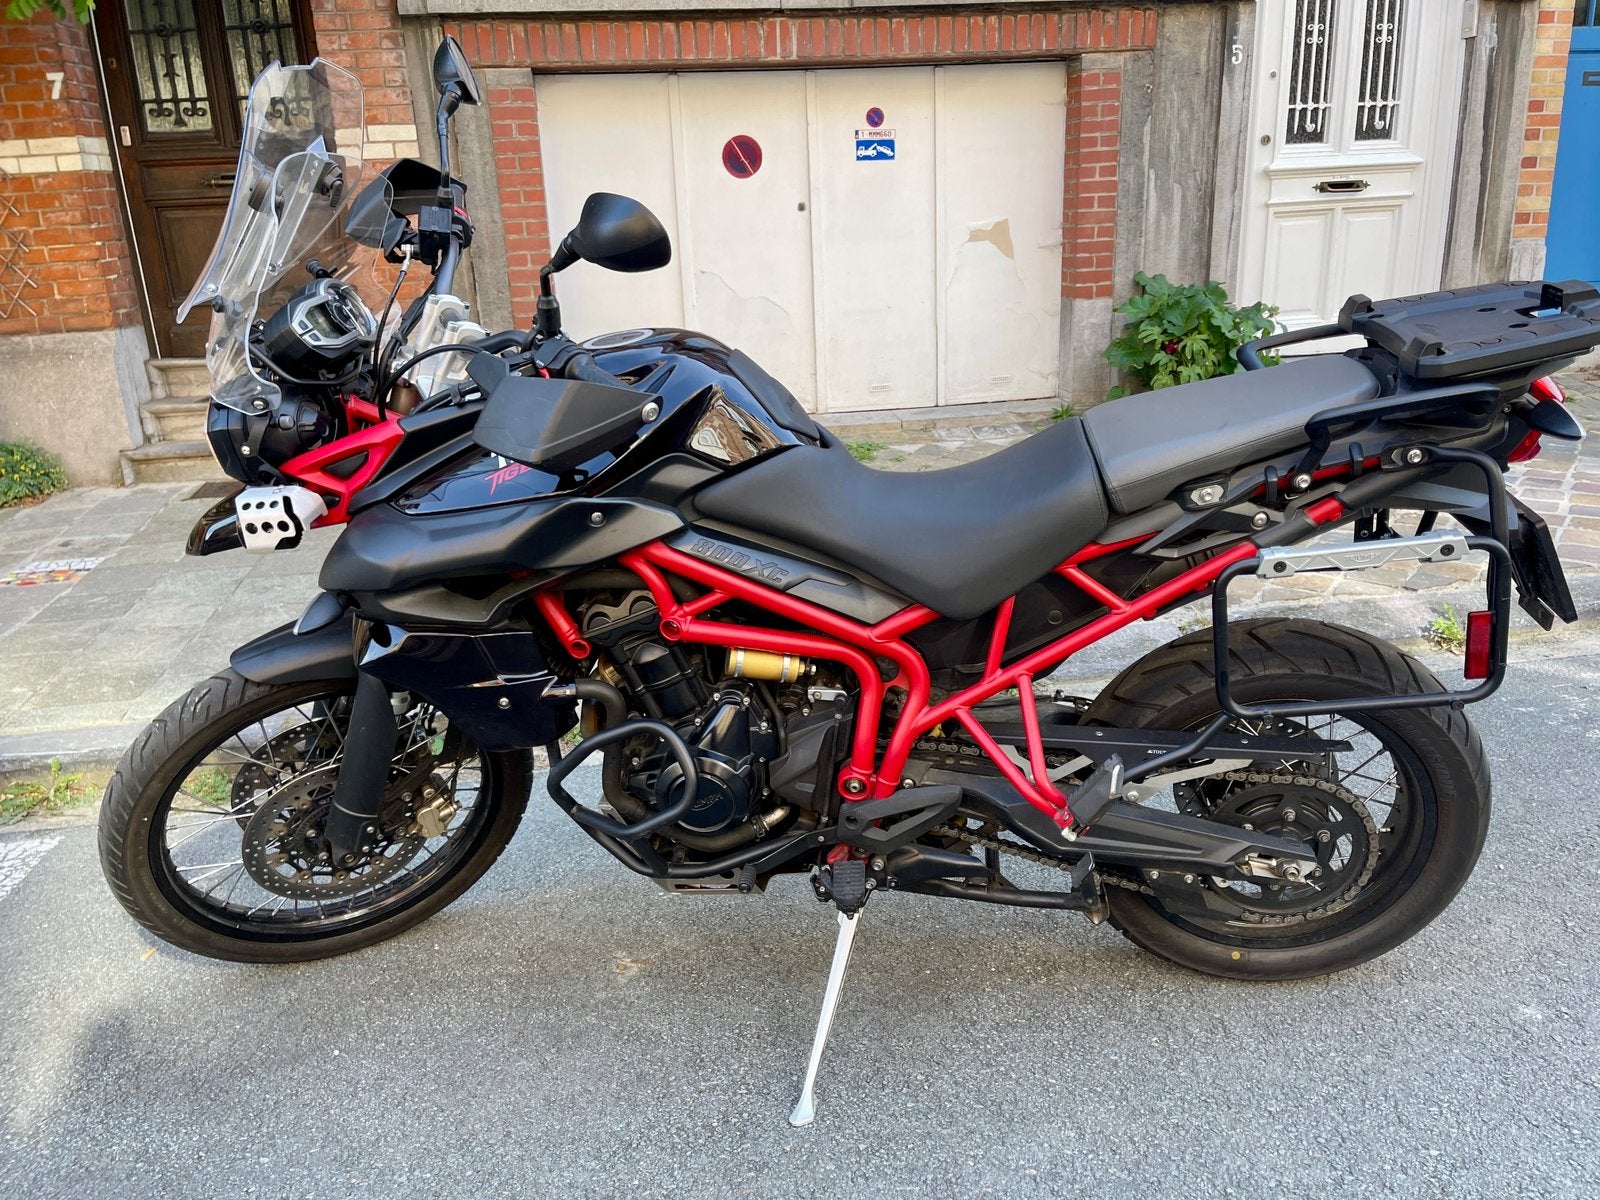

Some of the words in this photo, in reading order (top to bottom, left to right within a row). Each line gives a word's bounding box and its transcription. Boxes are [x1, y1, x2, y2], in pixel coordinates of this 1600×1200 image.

[1231, 44, 1243, 65] 5
[46, 72, 65, 100] 7
[484, 462, 533, 496] TIGE
